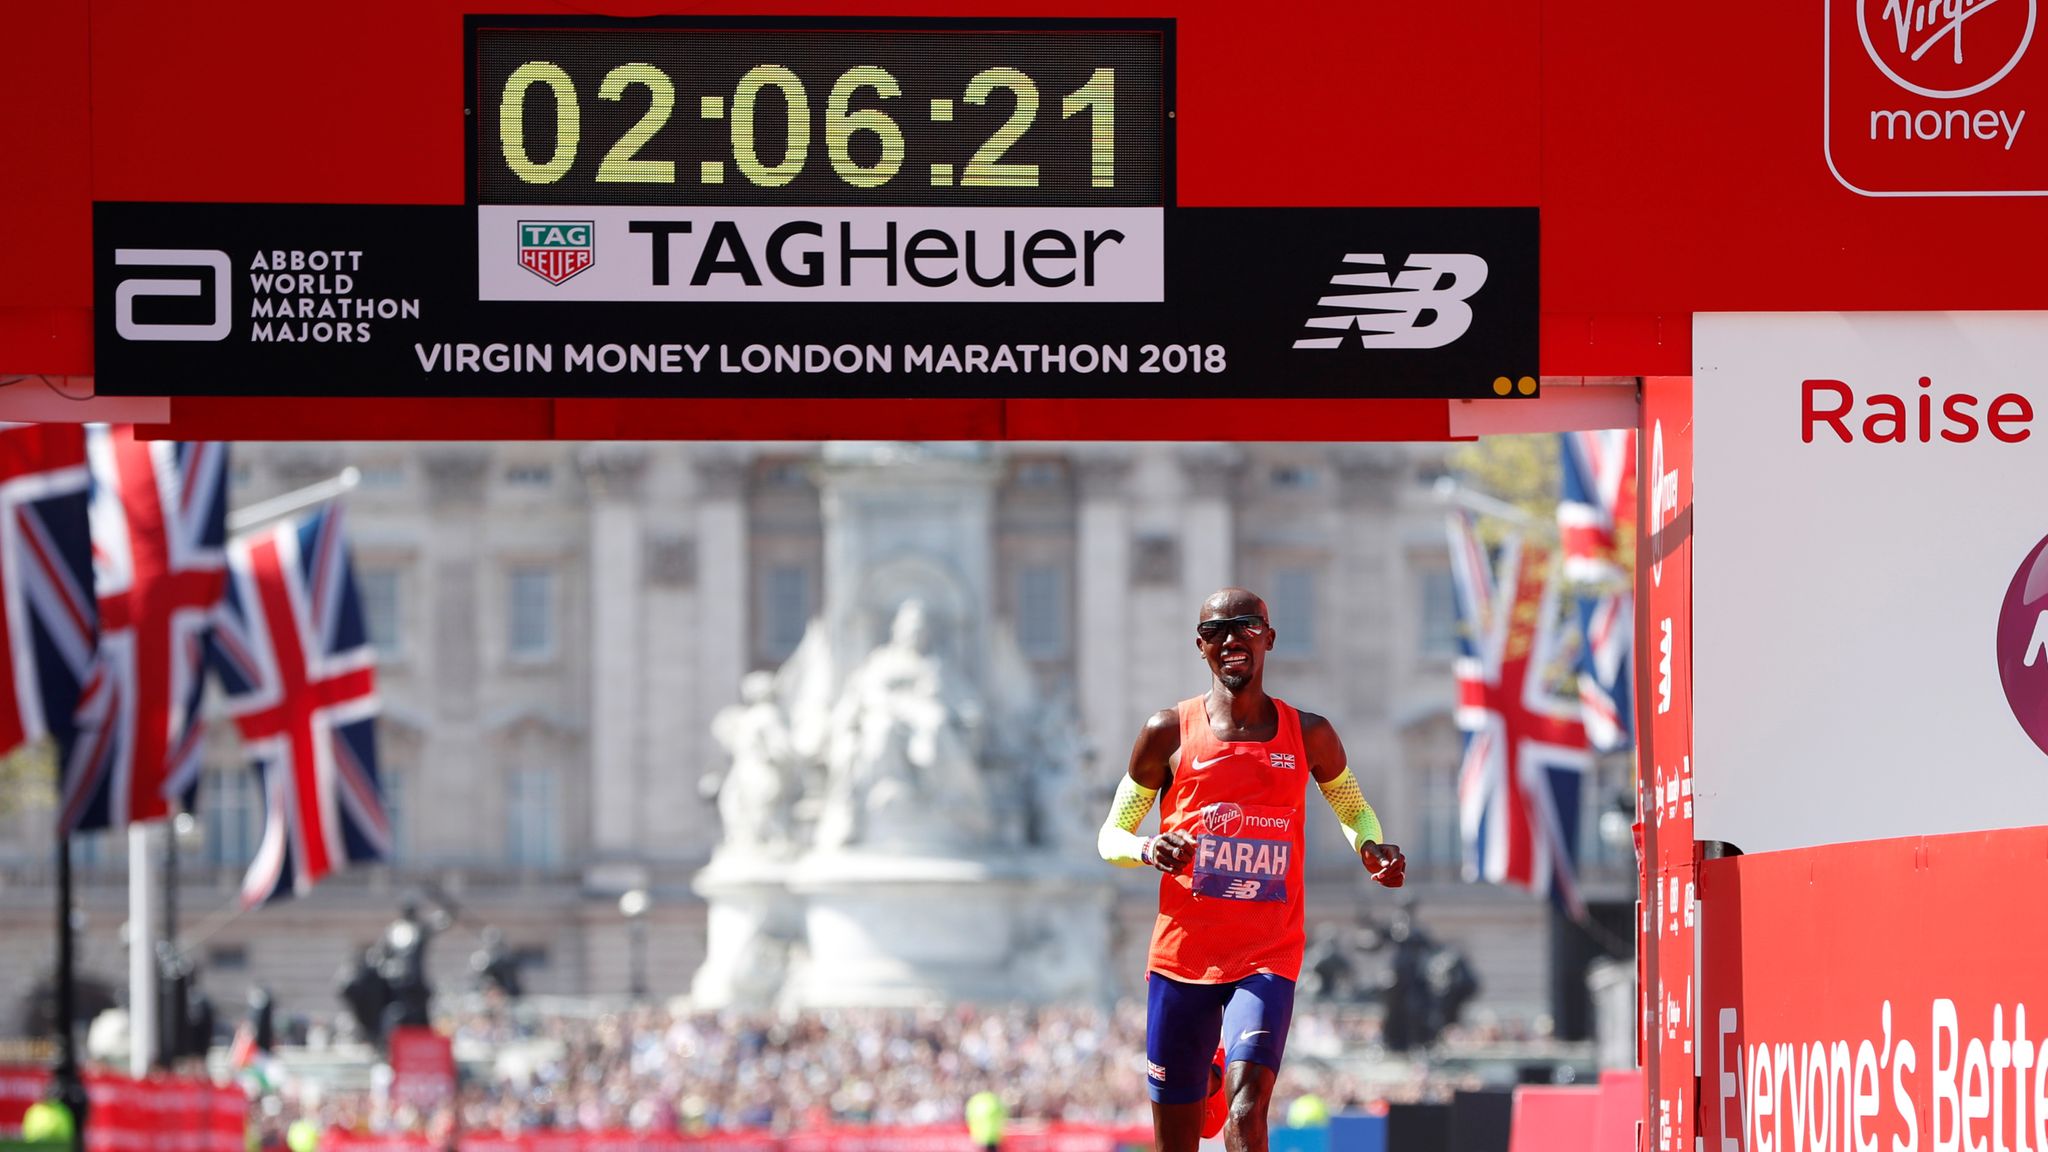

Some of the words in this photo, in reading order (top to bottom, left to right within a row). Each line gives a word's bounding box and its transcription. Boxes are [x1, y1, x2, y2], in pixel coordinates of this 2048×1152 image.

[499, 61, 1115, 188] 02:06:21
[1870, 109, 2026, 151] money
[525, 226, 587, 245] TAG
[250, 250, 363, 271] ABBOTT
[523, 251, 589, 281] HEUER
[250, 273, 354, 295] WORLD
[251, 298, 420, 319] MARATHON
[251, 321, 371, 343] MAJORS
[415, 343, 552, 374] VIRGIN
[564, 343, 710, 374] MONEY
[720, 343, 892, 374] LONDON
[904, 343, 1128, 374] MARATHON
[1138, 343, 1227, 374] 2018
[1801, 376, 2034, 444] Raise
[1245, 815, 1290, 832] money
[1198, 838, 1288, 876] FARAH
